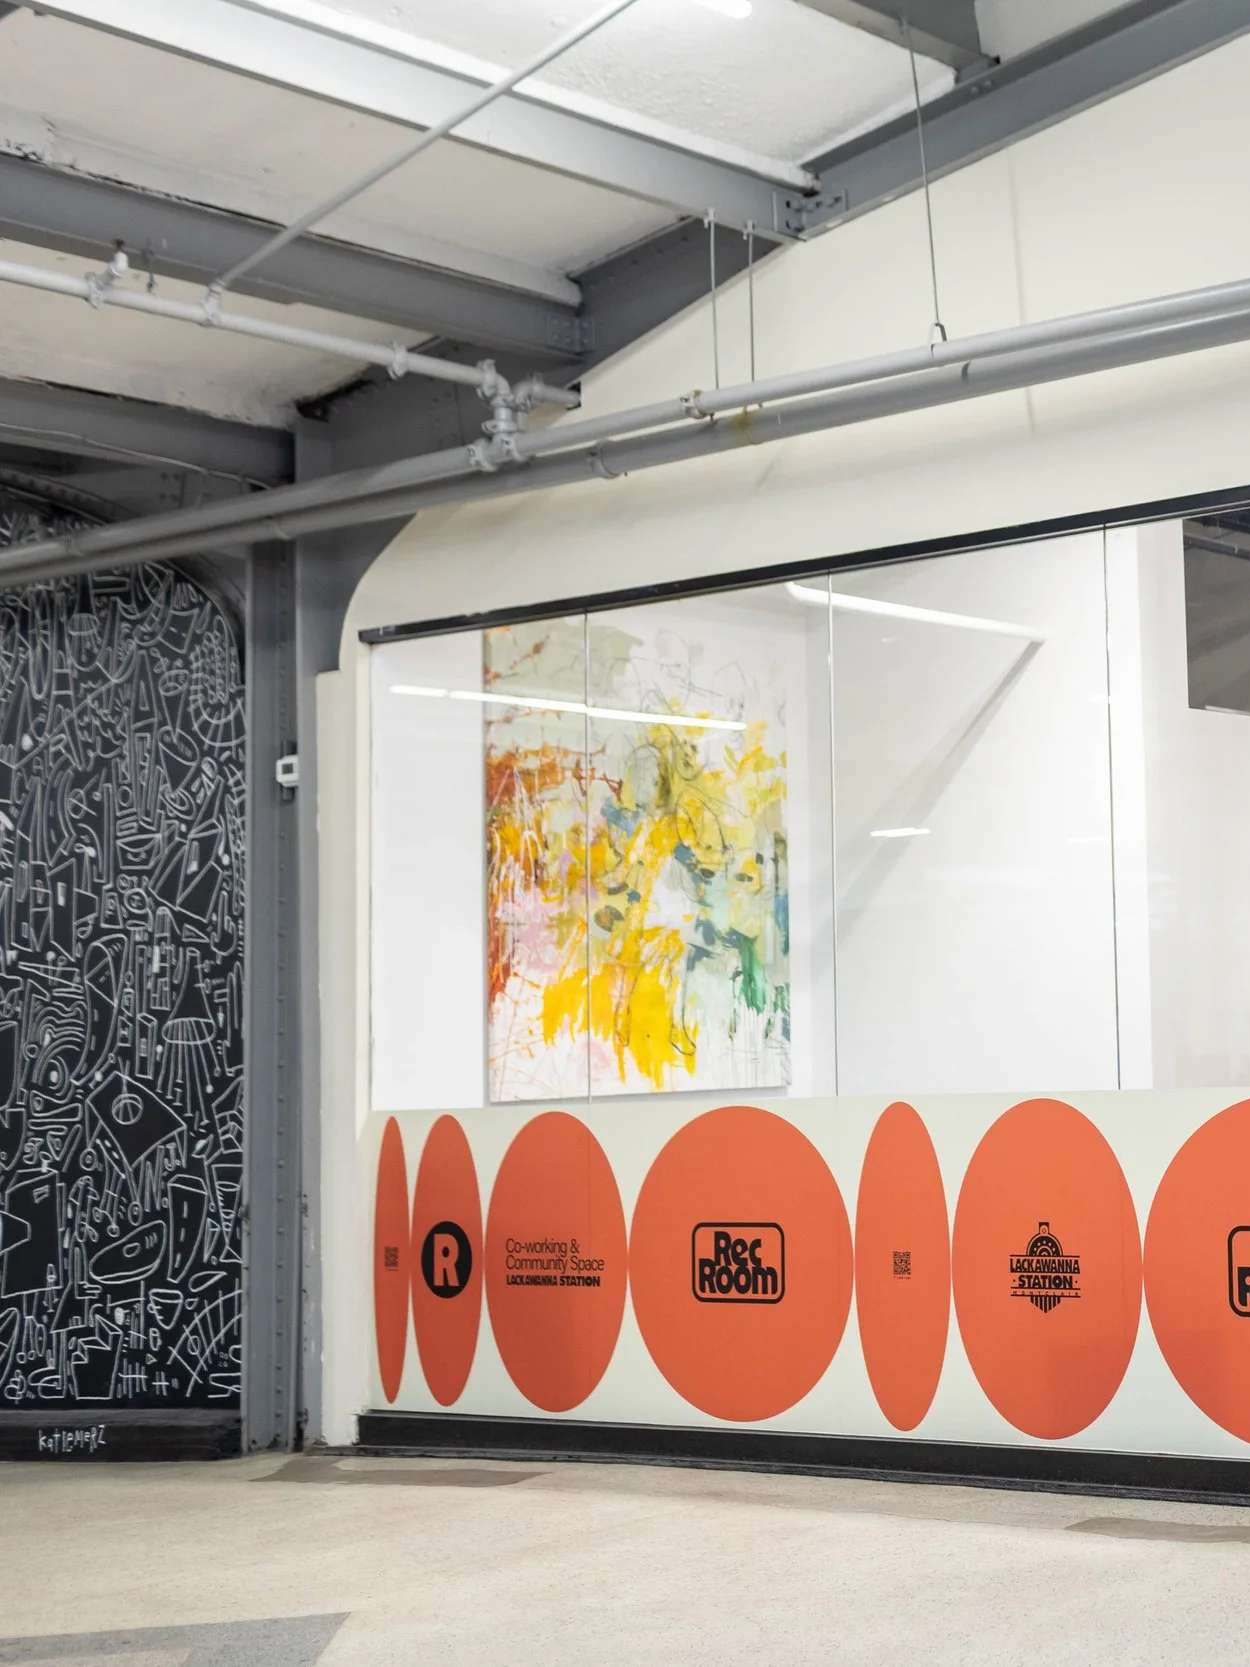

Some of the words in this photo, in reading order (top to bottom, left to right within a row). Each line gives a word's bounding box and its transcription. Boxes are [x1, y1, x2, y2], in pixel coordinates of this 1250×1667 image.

[506, 1238, 567, 1257] Co-working
[570, 1239, 580, 1254] &
[714, 1231, 762, 1269] Rec
[433, 1233, 460, 1287] R
[506, 1255, 568, 1274] Community
[570, 1256, 605, 1274] Space
[1010, 1259, 1080, 1274] LACKAWANNA
[506, 1275, 557, 1286] LACKAWANNA
[560, 1276, 600, 1287] STATION
[699, 1257, 779, 1294] Room
[1018, 1275, 1073, 1289] STATION
